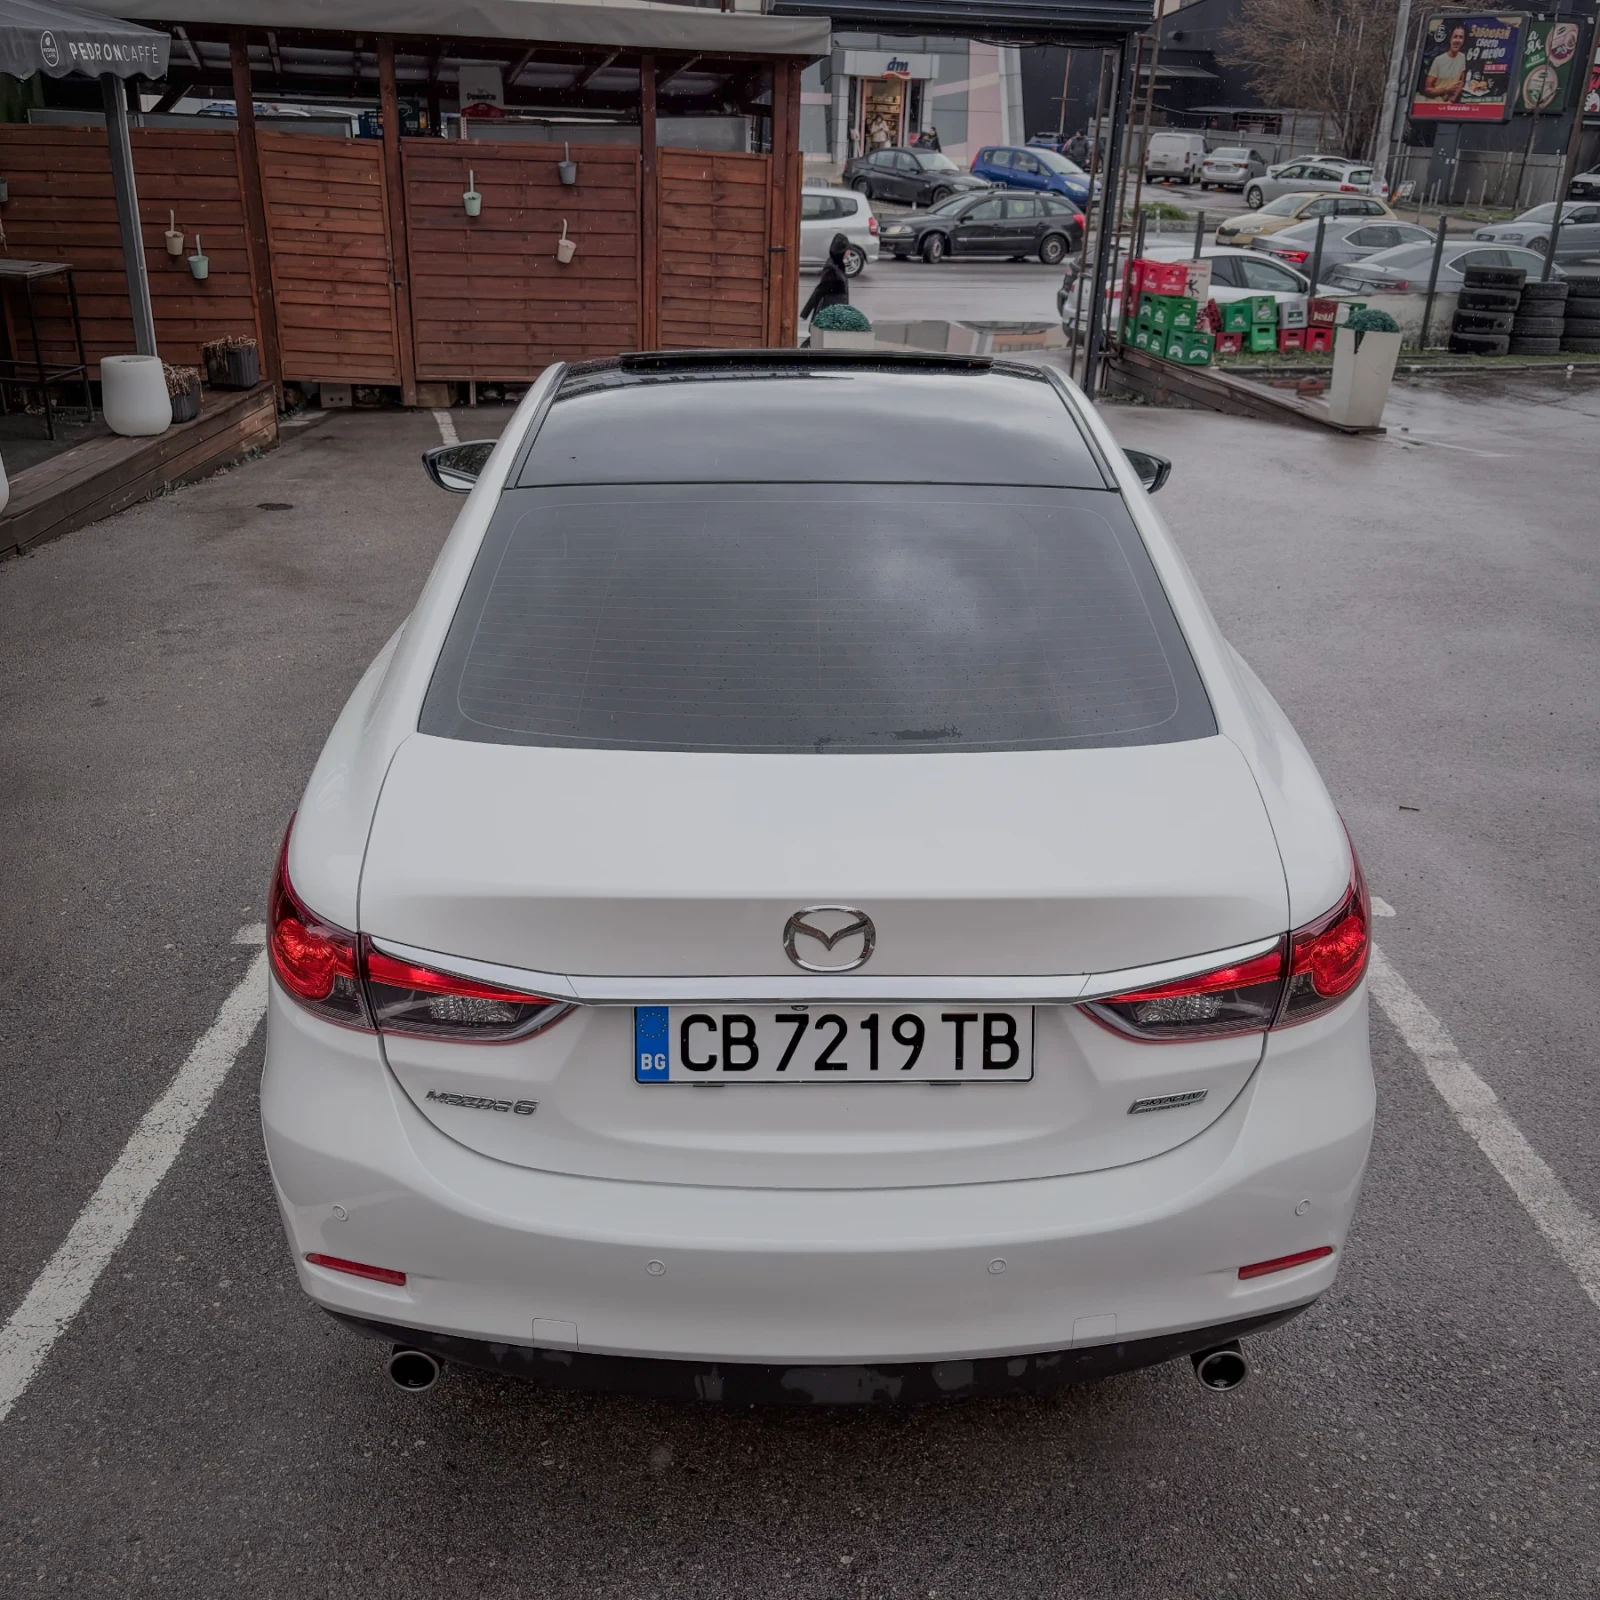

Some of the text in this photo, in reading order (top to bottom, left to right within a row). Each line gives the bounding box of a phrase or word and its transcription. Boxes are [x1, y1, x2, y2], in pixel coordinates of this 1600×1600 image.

[887, 57, 909, 72] dm
[680, 1013, 1020, 1071] CB 7219 TB
[641, 1053, 666, 1070] BG
[513, 1098, 539, 1116] 6
